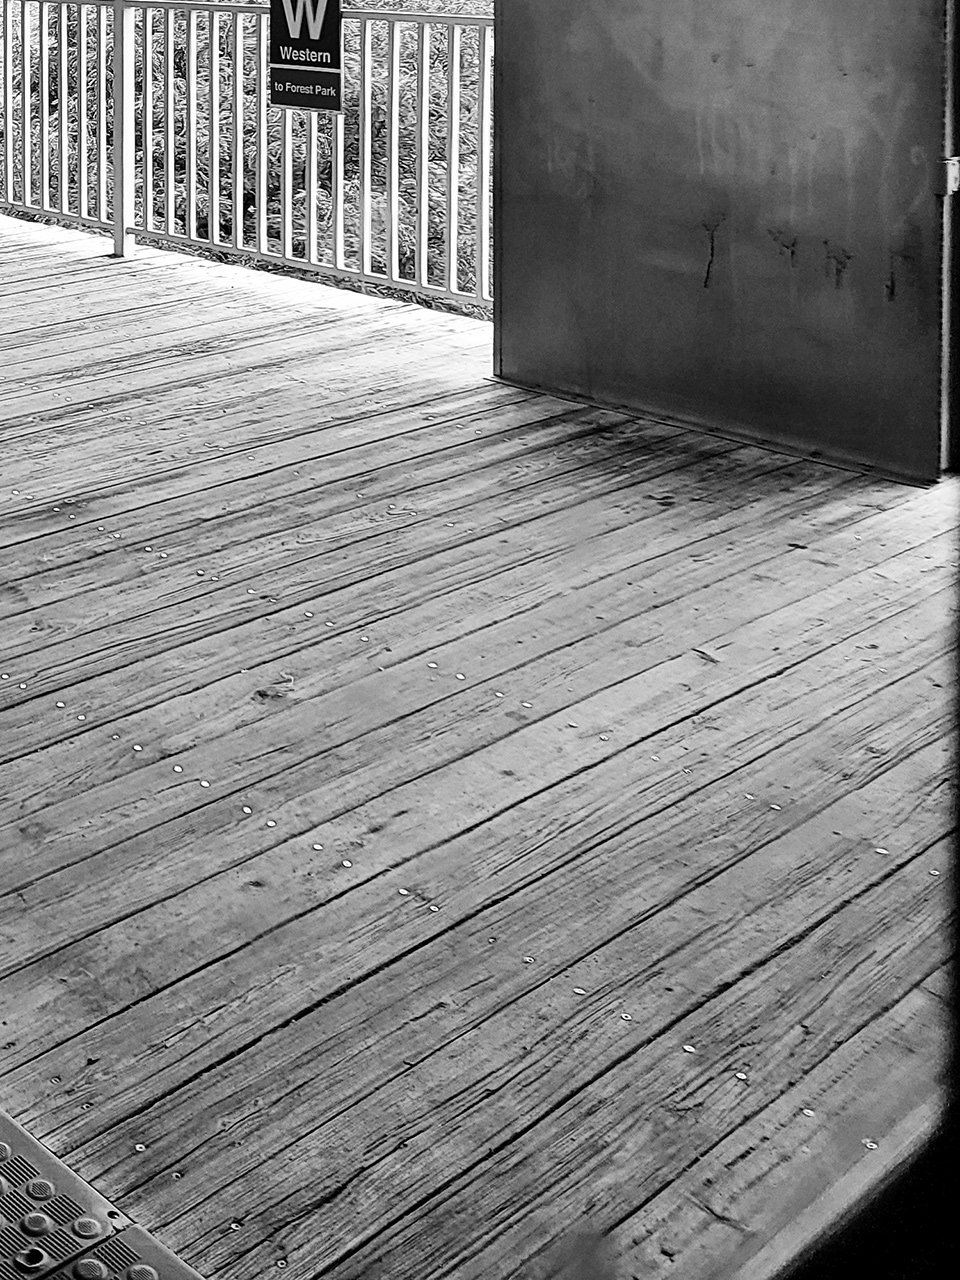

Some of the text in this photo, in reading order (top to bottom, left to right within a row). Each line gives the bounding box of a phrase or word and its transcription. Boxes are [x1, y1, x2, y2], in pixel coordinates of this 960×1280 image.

[279, 46, 331, 63] Western
[274, 81, 336, 97] to Forest Park
